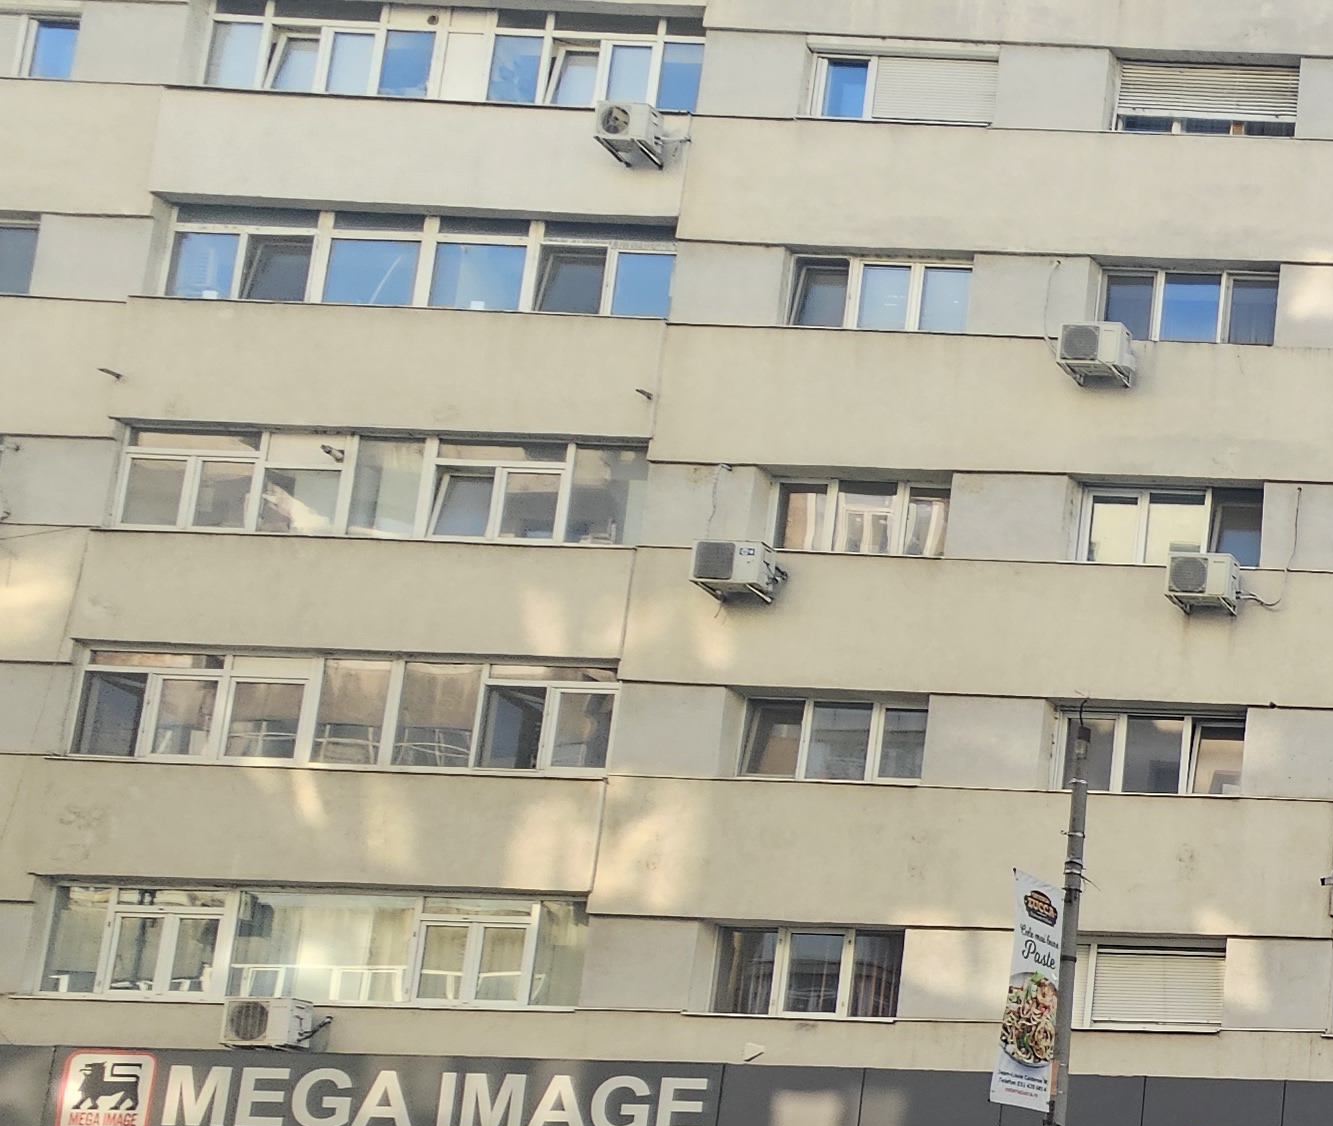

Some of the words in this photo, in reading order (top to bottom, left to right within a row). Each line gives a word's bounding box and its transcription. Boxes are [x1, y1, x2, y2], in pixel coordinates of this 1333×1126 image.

[1022, 940, 1056, 970] Paste
[68, 1112, 100, 1126] MEGA
[102, 1113, 139, 1126] IMAGE
